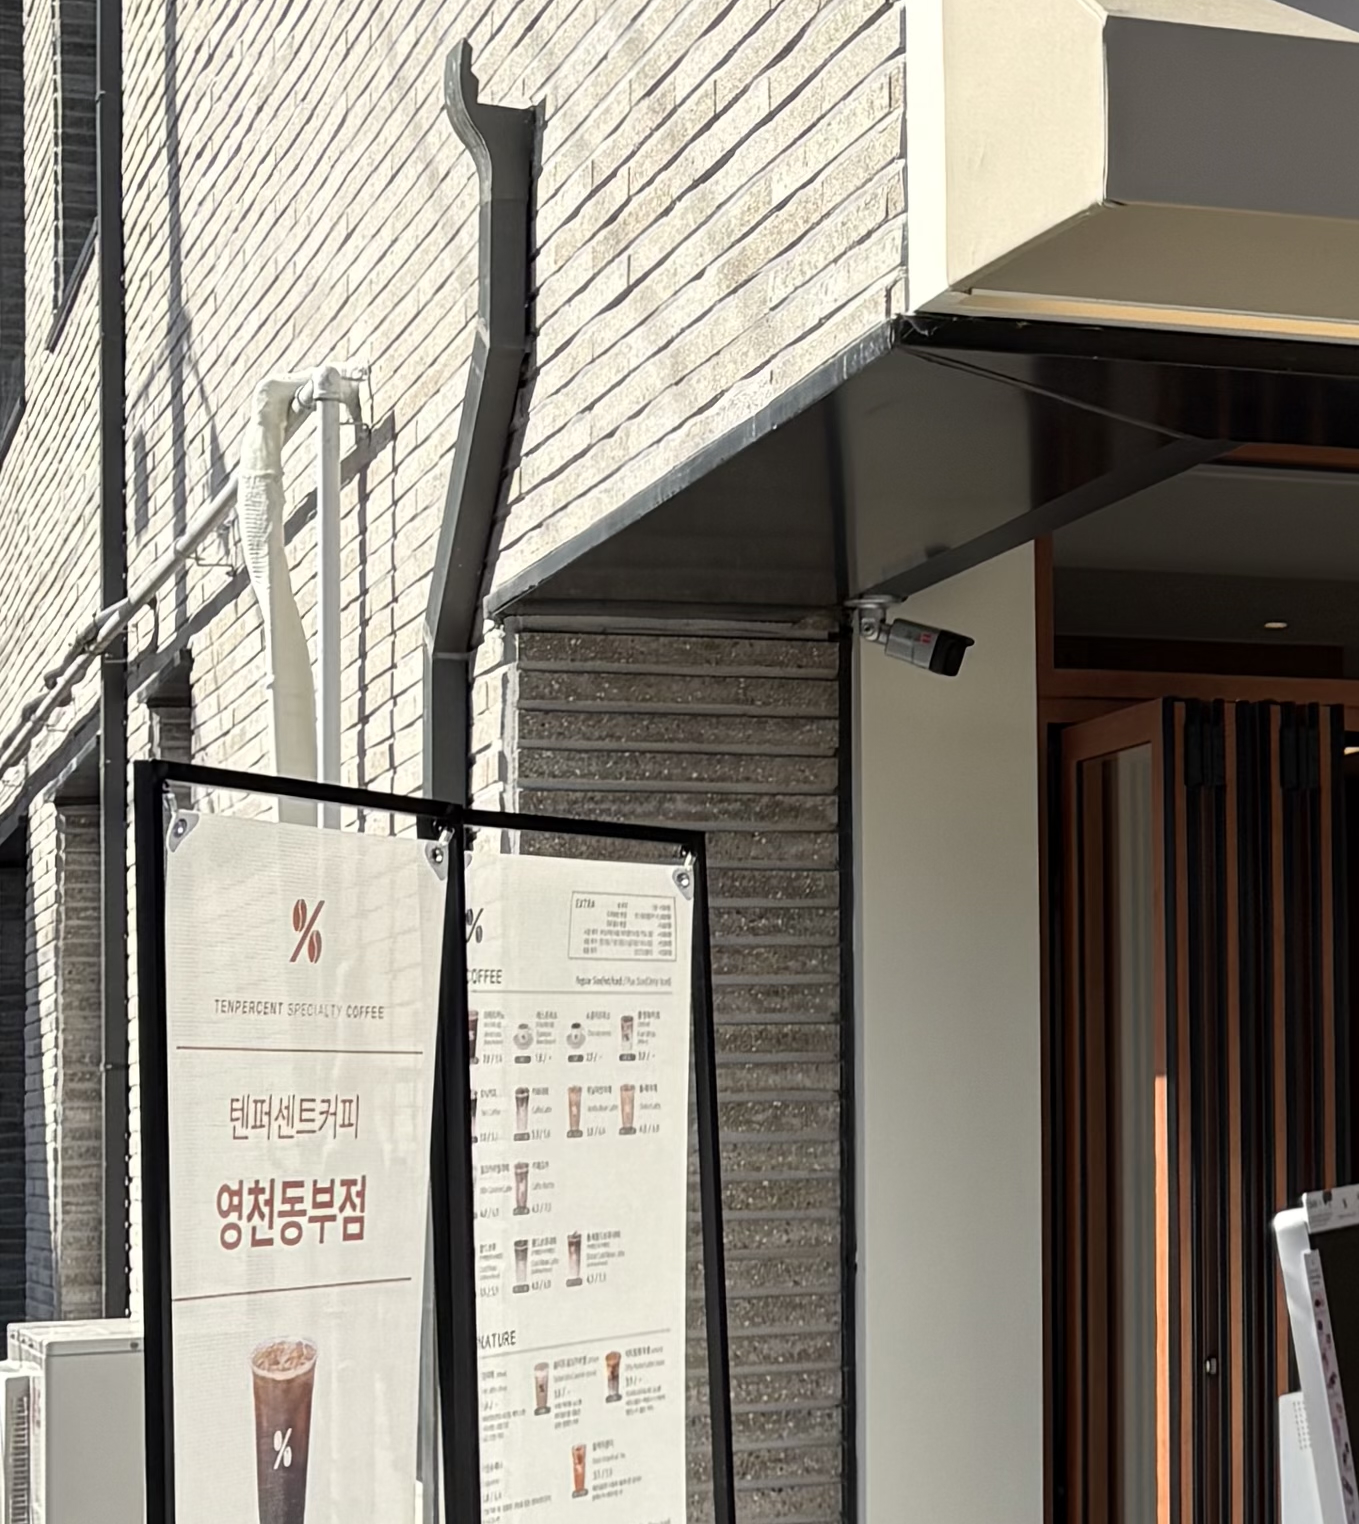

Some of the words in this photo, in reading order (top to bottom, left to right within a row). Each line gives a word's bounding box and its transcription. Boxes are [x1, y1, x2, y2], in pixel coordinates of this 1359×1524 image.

[214, 998, 284, 1017] TENPERCENT
[287, 1001, 343, 1019] SPECIALTY
[346, 1004, 385, 1021] COFFEE
[229, 1094, 361, 1141] 텐퍼센트커피
[216, 1174, 368, 1251] 영천동부점
